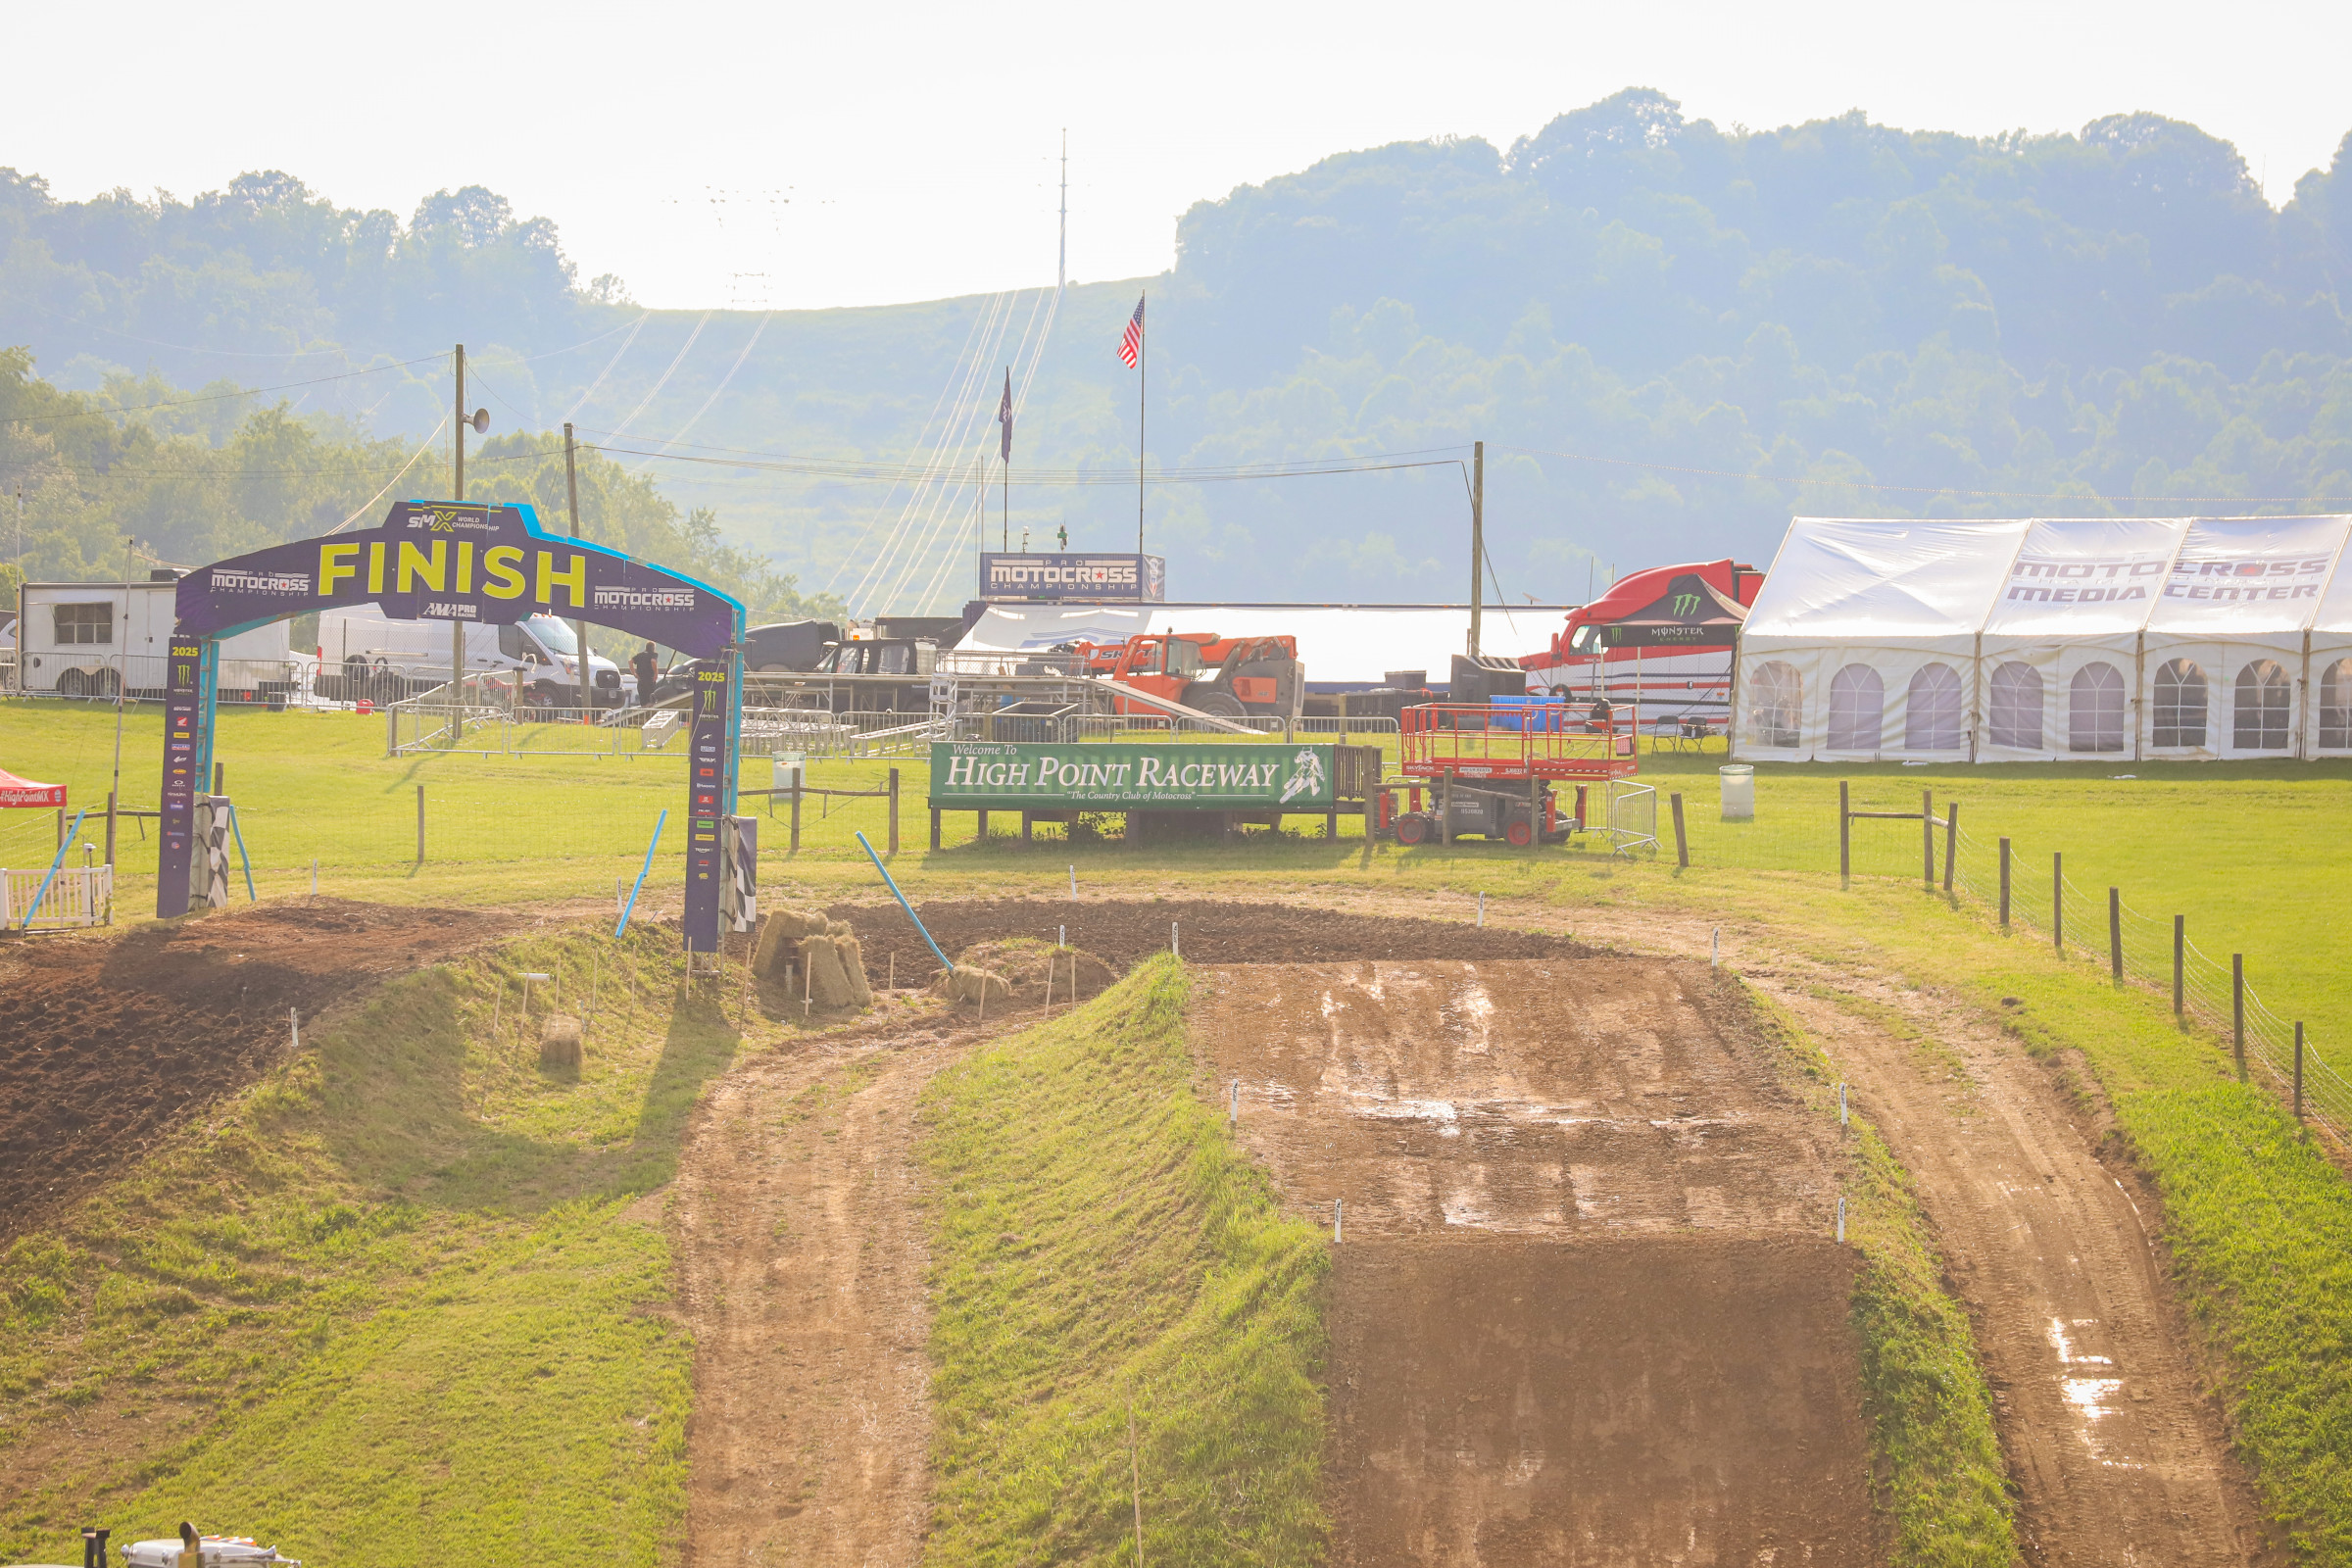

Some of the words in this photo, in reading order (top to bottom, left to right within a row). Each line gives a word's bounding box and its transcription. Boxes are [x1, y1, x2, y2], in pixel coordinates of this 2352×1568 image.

[407, 511, 457, 532] SMX
[452, 522, 500, 531] CHAMPIONSHIP
[318, 540, 585, 608] FINISH
[991, 566, 1137, 583] MOTOCROSS
[212, 574, 311, 591] MOTOCROSS
[211, 587, 309, 596] CHAMPIONSHIP
[2007, 586, 2146, 602] MEDIA
[2164, 584, 2319, 600] CENTER
[594, 592, 695, 607] MOTOCROSS
[422, 603, 458, 617] AMA
[458, 604, 476, 613] PRO
[1651, 626, 1703, 635] MONSTER
[172, 647, 199, 657] 2025
[698, 671, 725, 682] 2025
[953, 744, 1001, 755] Welcome
[1004, 744, 1017, 755] To
[944, 756, 1030, 786] HIGH
[1034, 757, 1131, 786] POINT
[1135, 757, 1280, 787] RACEWAY
[0, 790, 49, 806] #HighPointMX
[1087, 791, 1119, 801] Country
[1122, 791, 1141, 800] Club
[1142, 791, 1152, 802] of
